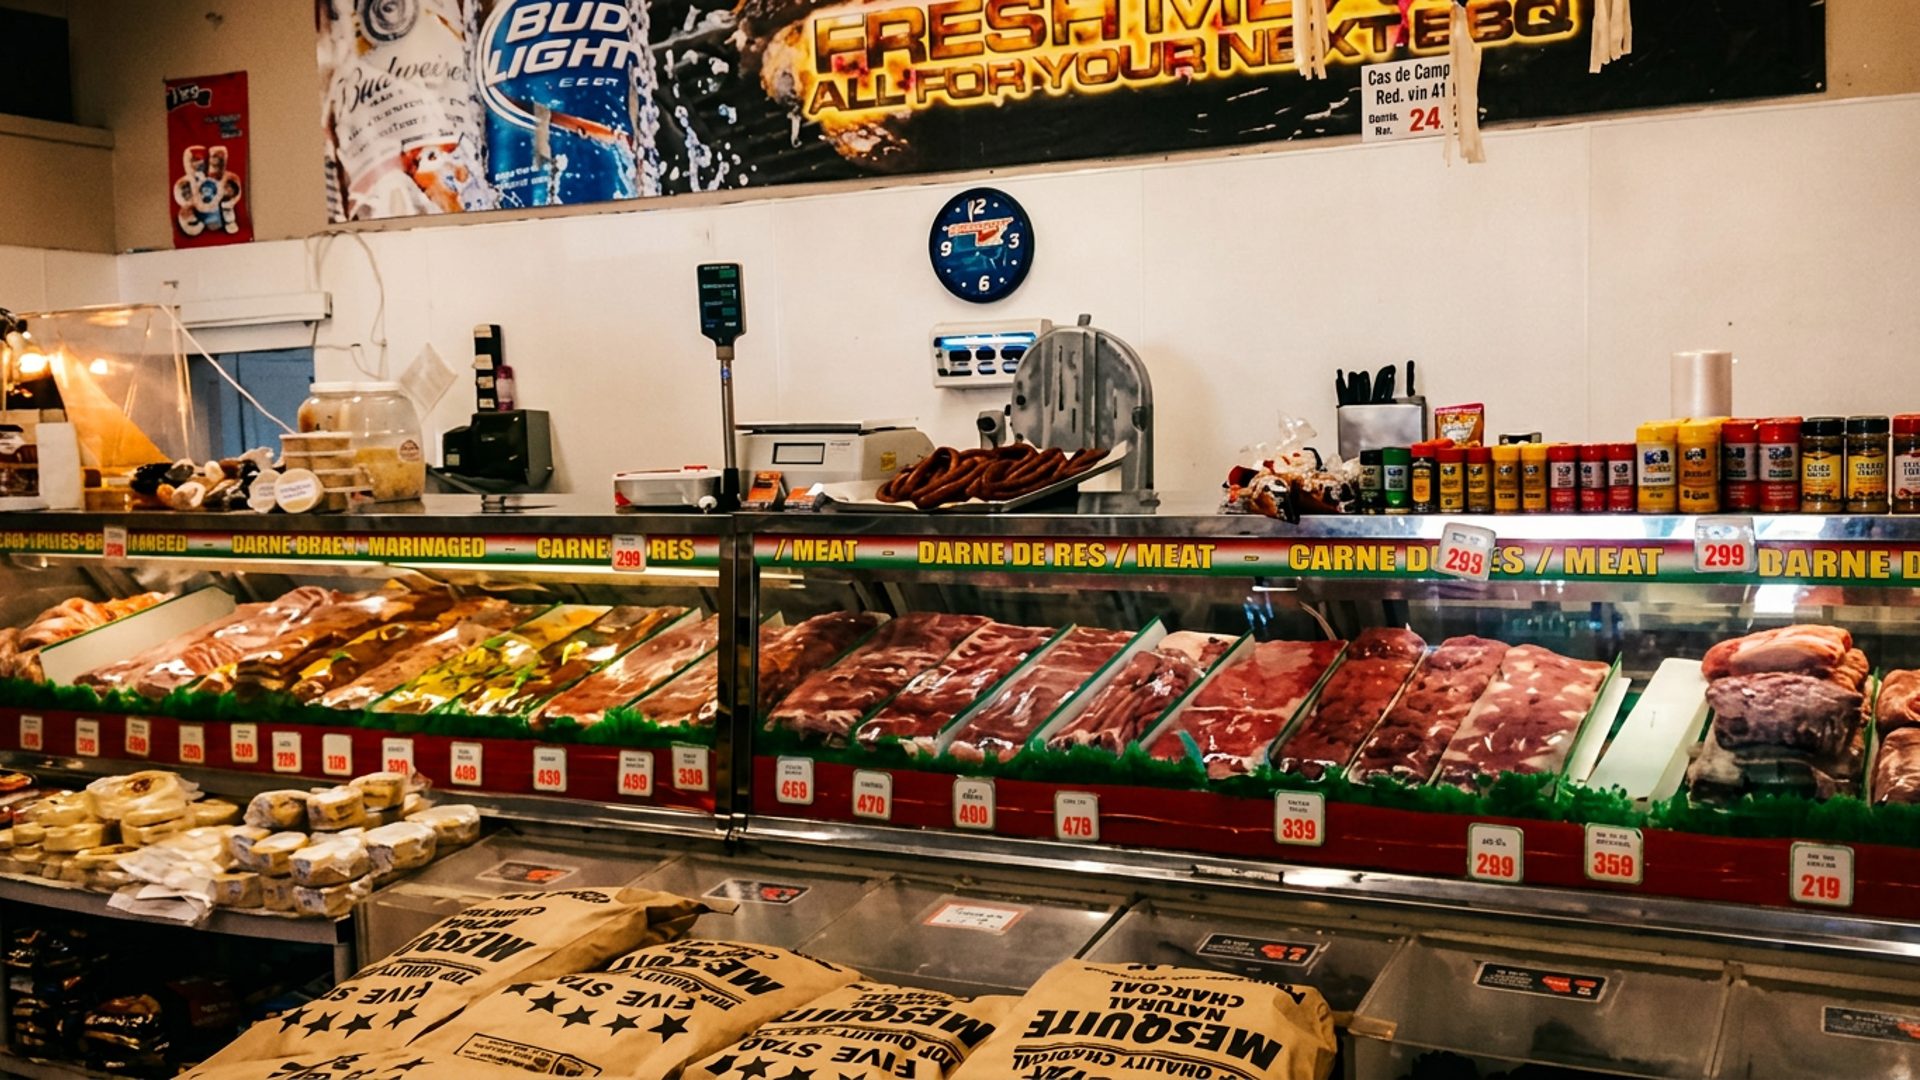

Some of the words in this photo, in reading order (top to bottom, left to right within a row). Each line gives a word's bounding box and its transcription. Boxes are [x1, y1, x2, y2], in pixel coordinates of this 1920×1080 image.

[505, 0, 630, 43] BUD
[813, 0, 1121, 74] FRESH
[487, 39, 642, 87] LIGHT
[808, 74, 907, 115] ALL
[915, 57, 1026, 104] FOR
[1034, 37, 1208, 90] YOUR
[1218, 13, 1402, 71] NEXT
[1368, 70, 1392, 86] Cas
[1395, 66, 1411, 82] de
[1376, 88, 1405, 106] Red.
[1408, 86, 1428, 102] vin
[940, 241, 953, 257] 9
[1008, 233, 1021, 249] 3
[979, 275, 991, 292] 6
[536, 538, 608, 559] CARNE
[651, 539, 696, 561] RES
[616, 550, 641, 567] 299
[792, 540, 859, 563] MEAT
[917, 541, 1005, 566] DARNE
[1011, 542, 1046, 566] DE
[1053, 543, 1106, 568] RES
[1136, 544, 1217, 570] MEAT
[1288, 544, 1396, 572] CARNE
[1564, 547, 1664, 577] MEAT
[1704, 543, 1745, 567] 299
[1283, 818, 1317, 841] 339
[1476, 853, 1514, 878] 299
[1594, 852, 1634, 877] 359
[1801, 874, 1841, 900] 219
[358, 981, 434, 1005] FIVE
[615, 990, 697, 1011] FIVE
[1109, 980, 1245, 1009] CHARCOAL
[1108, 996, 1227, 1023] NATURAL
[1022, 1009, 1283, 1072] MESQUITE
[830, 1047, 917, 1080] FIVE
